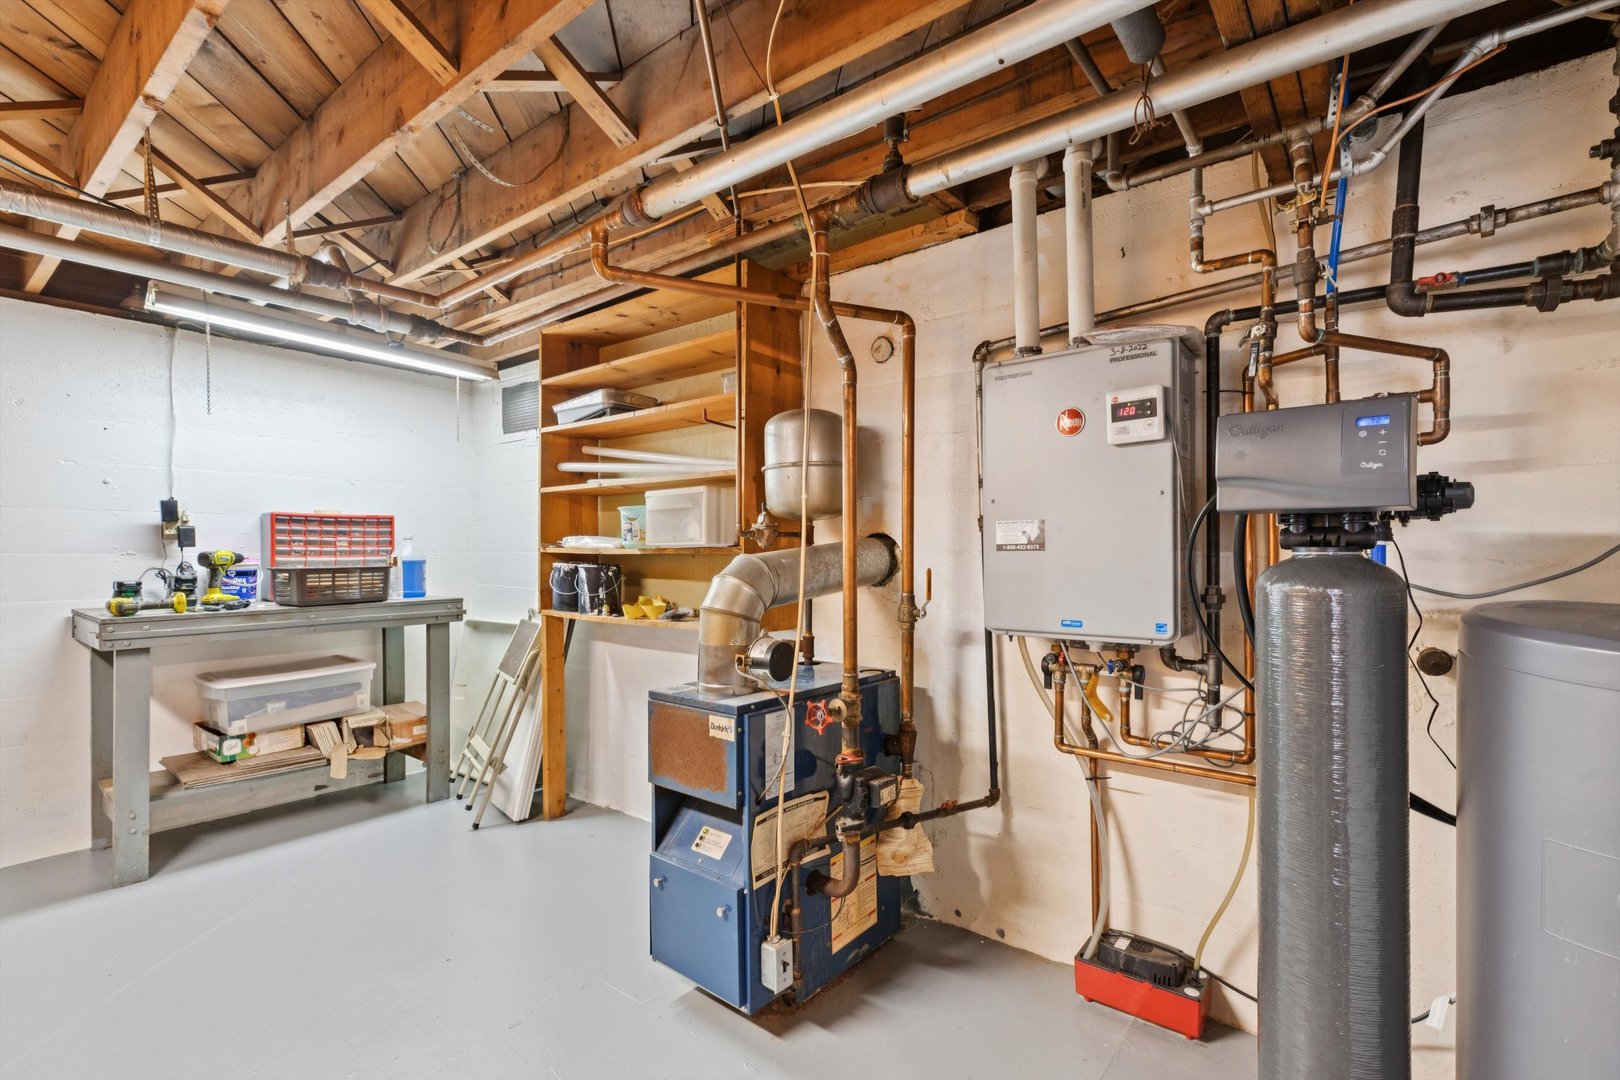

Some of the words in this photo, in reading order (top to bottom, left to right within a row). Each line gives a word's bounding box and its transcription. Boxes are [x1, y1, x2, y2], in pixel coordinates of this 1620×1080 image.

[1110, 351, 1157, 363] PROFESSIONAL
[1120, 406, 1136, 416] 120
[1228, 423, 1285, 439] Culligan
[1360, 461, 1383, 469] Culligan
